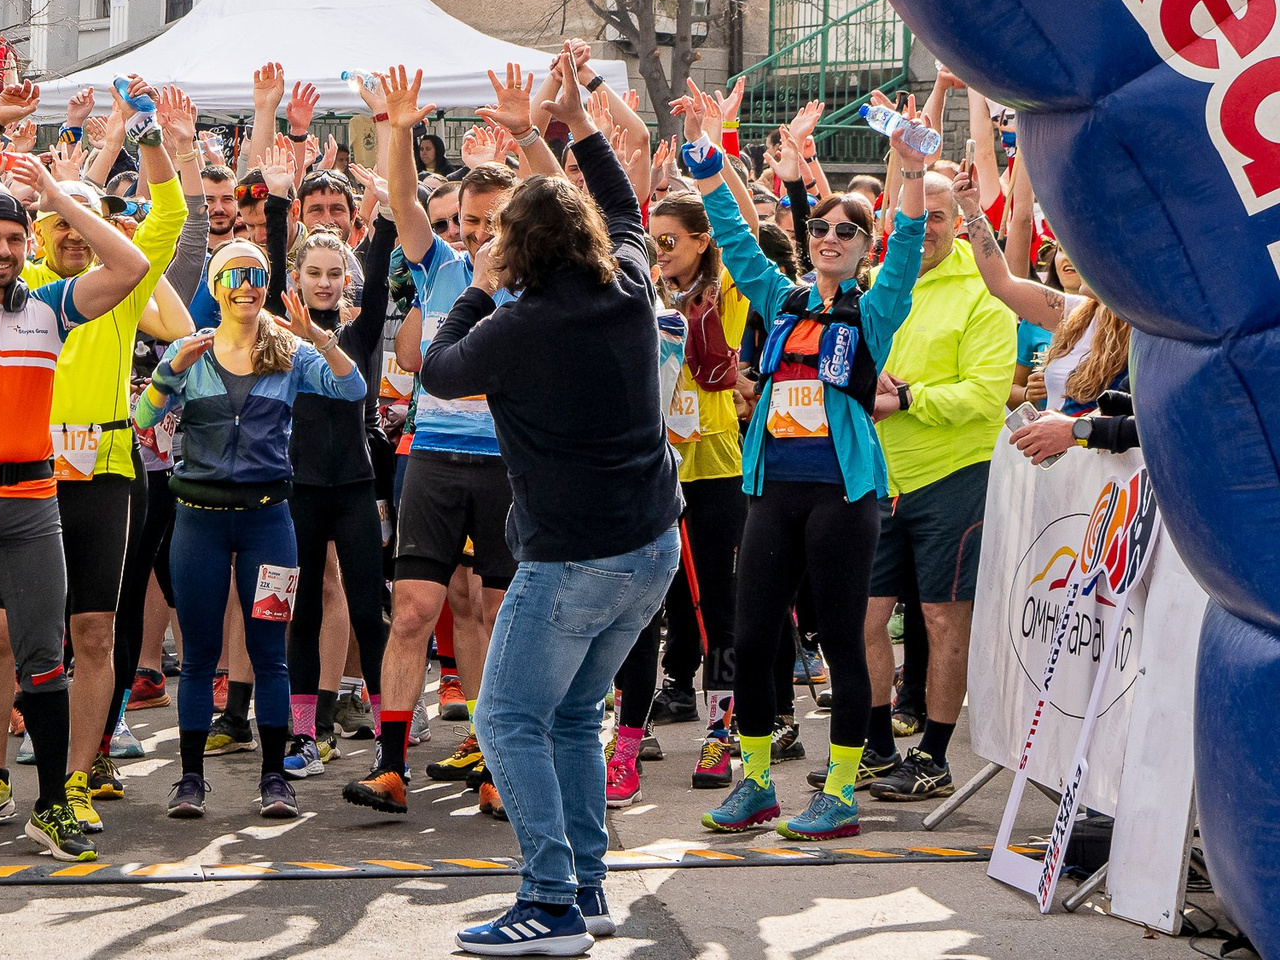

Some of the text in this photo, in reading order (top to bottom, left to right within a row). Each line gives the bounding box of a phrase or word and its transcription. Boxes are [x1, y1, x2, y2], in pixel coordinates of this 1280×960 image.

[830, 326, 850, 377] GEOPS
[788, 386, 824, 407] 1184
[63, 430, 98, 451] 1175
[260, 581, 271, 589] 22K
[1019, 583, 1079, 770] PLOVDIV HILLS
[1038, 784, 1071, 897] MATTERS
[1041, 763, 1082, 907] EVERY STEP
